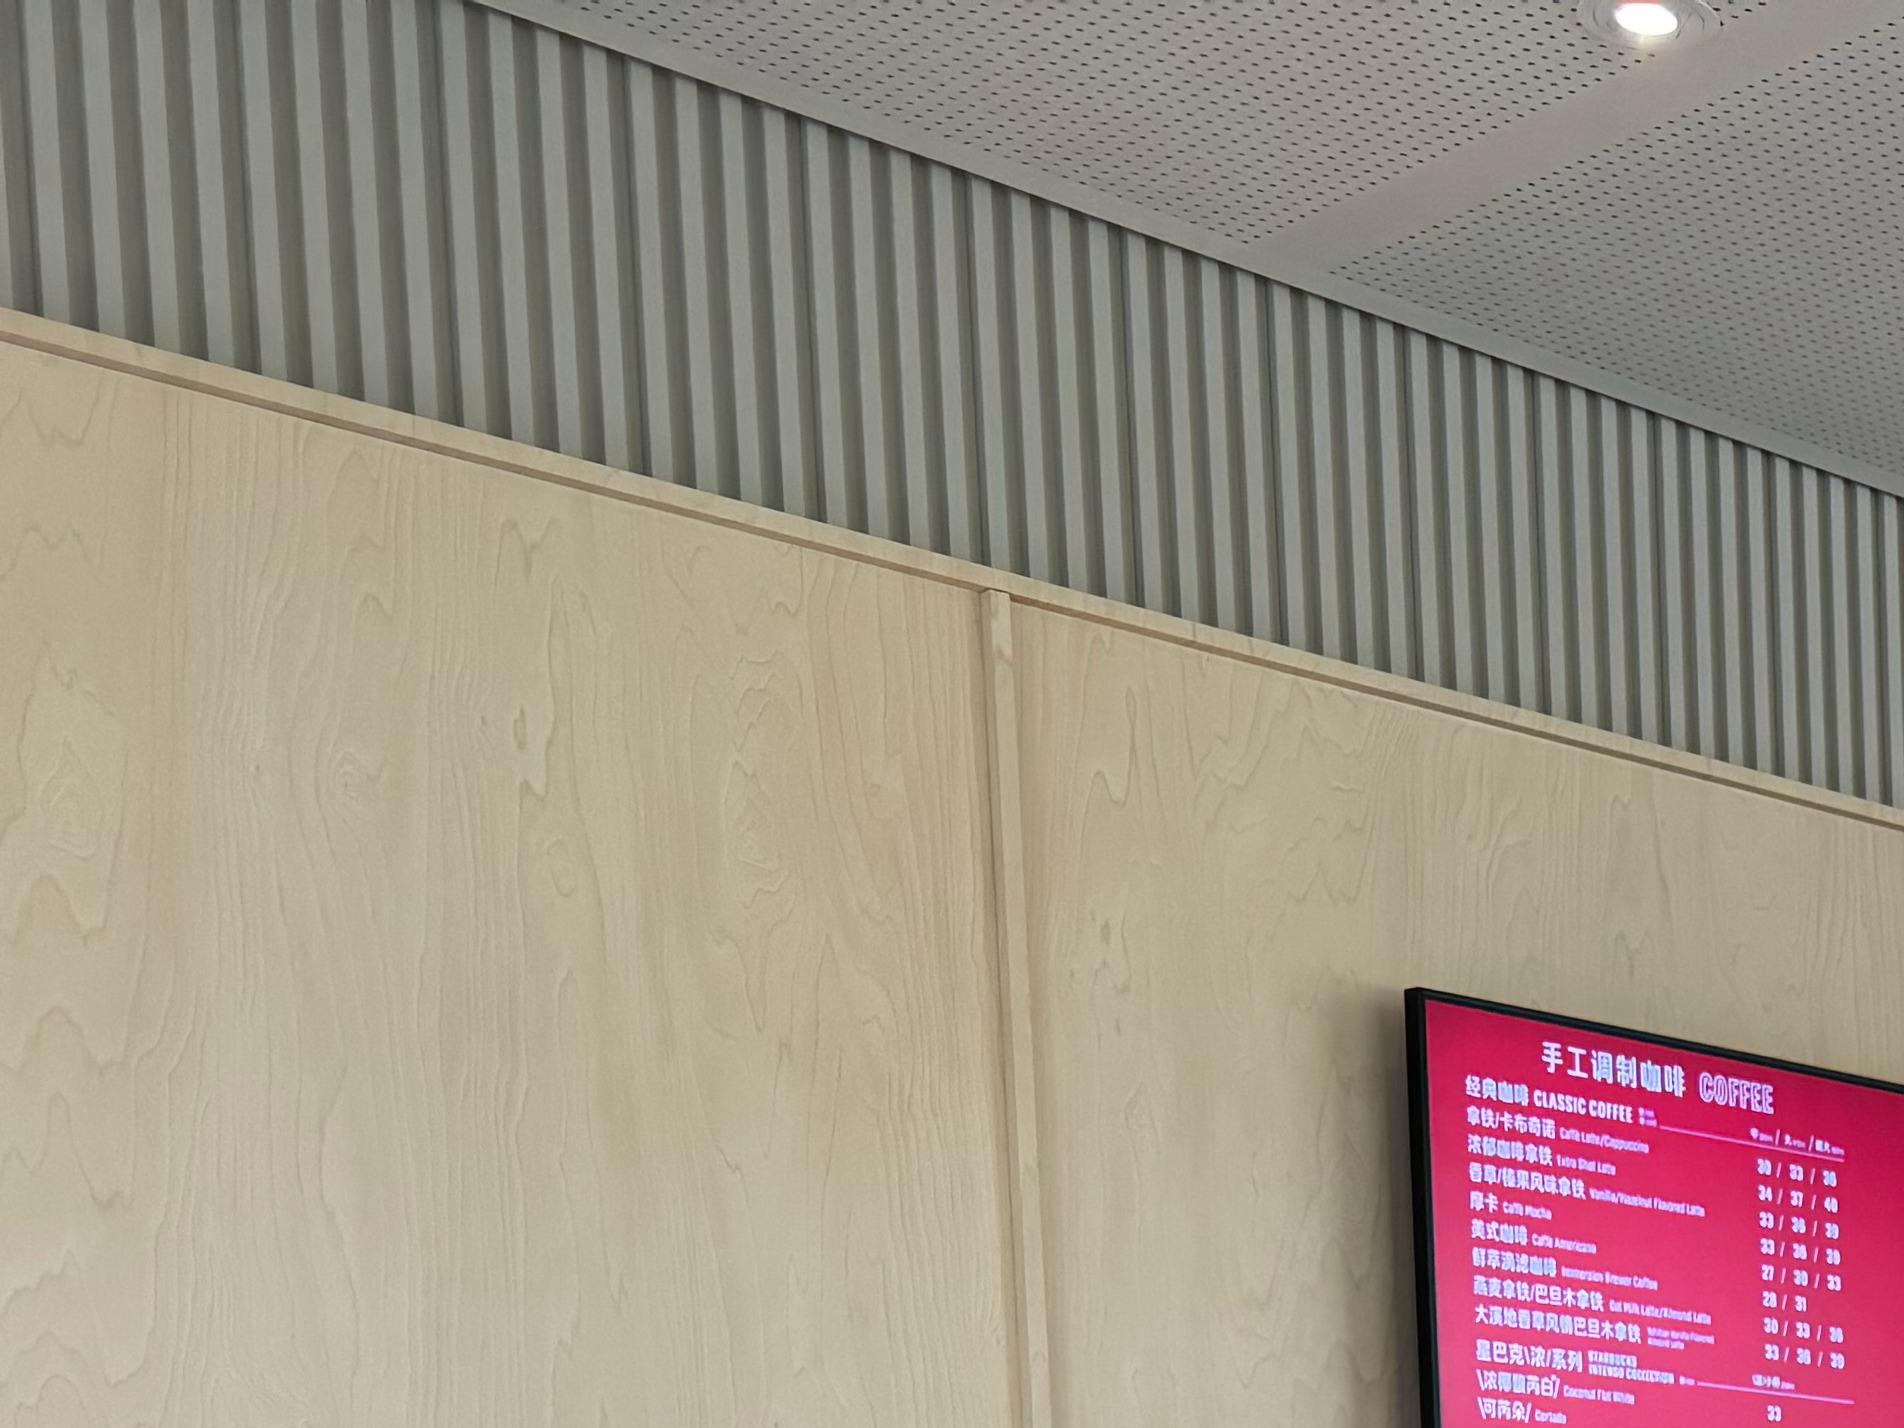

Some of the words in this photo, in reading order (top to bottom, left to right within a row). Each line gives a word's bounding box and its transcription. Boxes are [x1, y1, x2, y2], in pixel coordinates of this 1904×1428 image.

[1542, 1041, 1686, 1098] 手工调制咖啡
[1699, 1072, 1774, 1114] COFFEE
[1465, 1075, 1528, 1106] 经典咖啡
[1533, 1090, 1586, 1115] CLASSIC
[1589, 1101, 1633, 1123] COFFEE
[1467, 1106, 1556, 1139] 拿铁/卡布奇诺
[1470, 1191, 1498, 1213] 摩卡
[1471, 1219, 1527, 1247] 美式咖啡
